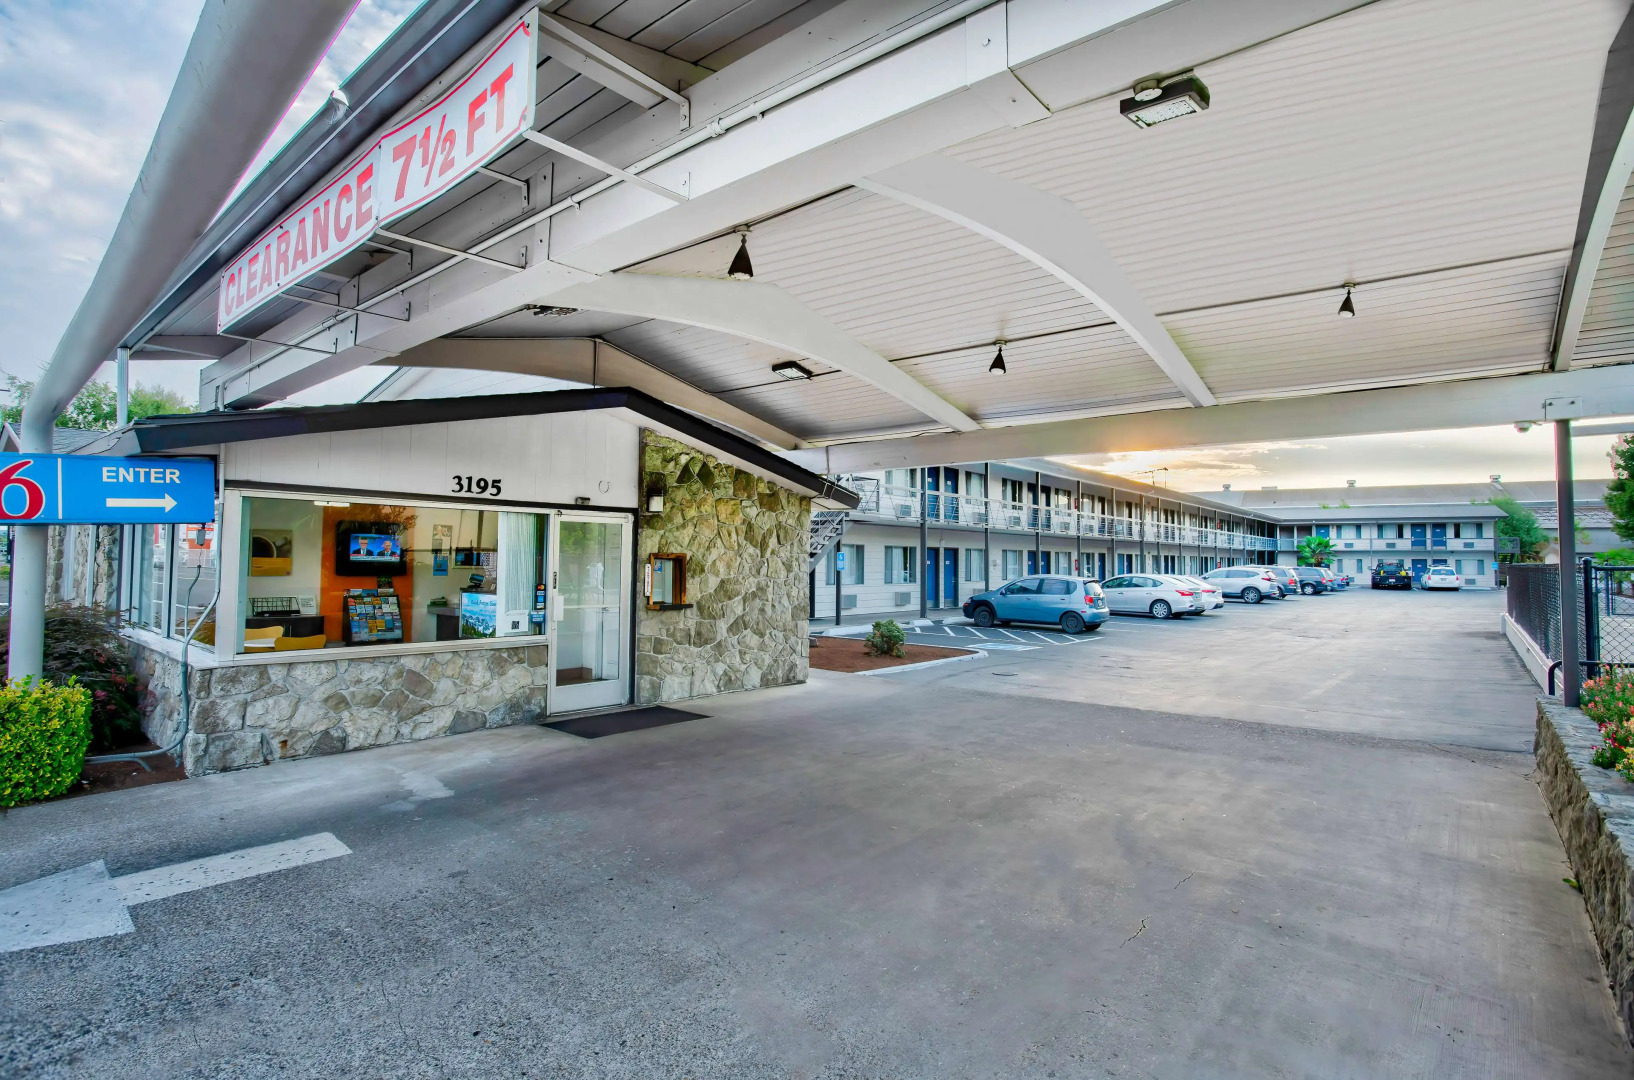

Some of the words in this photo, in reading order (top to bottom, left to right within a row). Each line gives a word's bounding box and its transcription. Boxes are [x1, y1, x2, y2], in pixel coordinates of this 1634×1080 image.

[224, 162, 374, 317] CLEARANCE
[465, 62, 514, 158] FT
[0, 459, 45, 519] 6
[102, 466, 181, 484] ENTER
[451, 475, 502, 496] 3195
